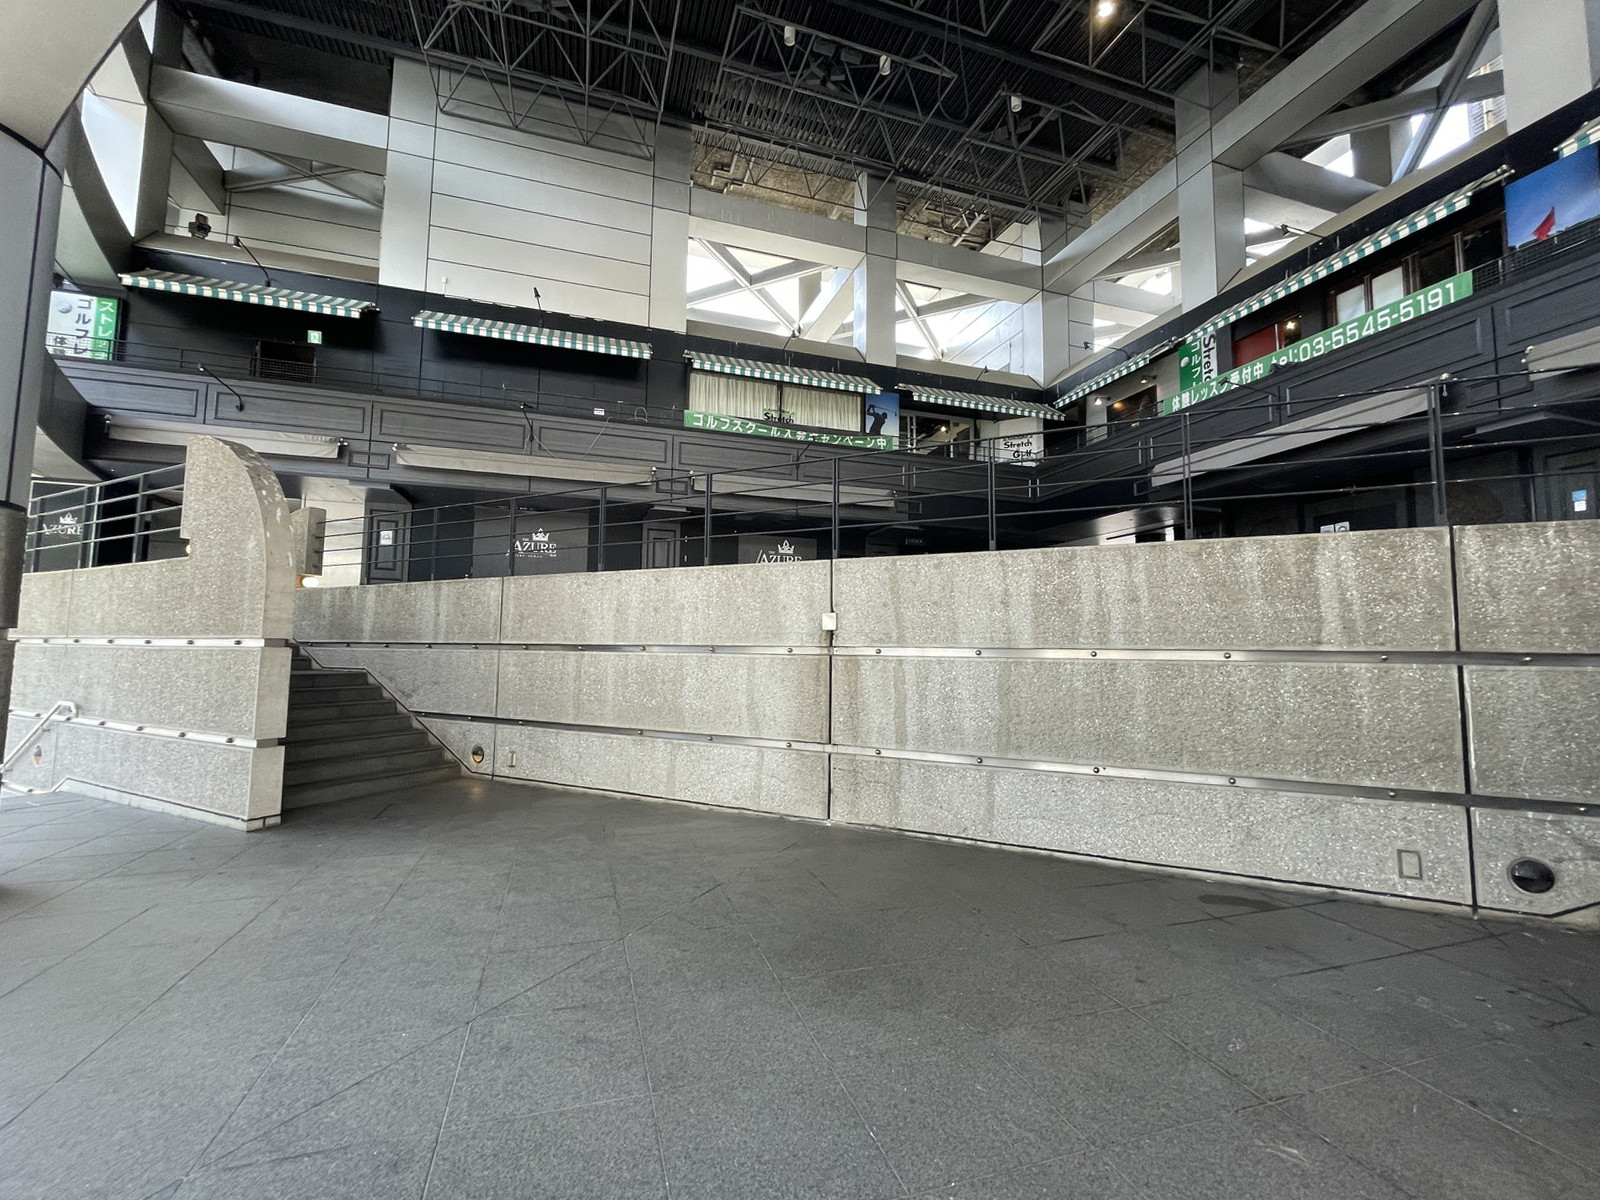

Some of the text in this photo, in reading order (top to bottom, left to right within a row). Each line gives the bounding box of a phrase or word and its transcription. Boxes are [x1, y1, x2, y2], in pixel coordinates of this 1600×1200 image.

[1190, 340, 1202, 387] ゴルフ
[1003, 439, 1033, 449] Stretch
[513, 540, 557, 554] AZURE
